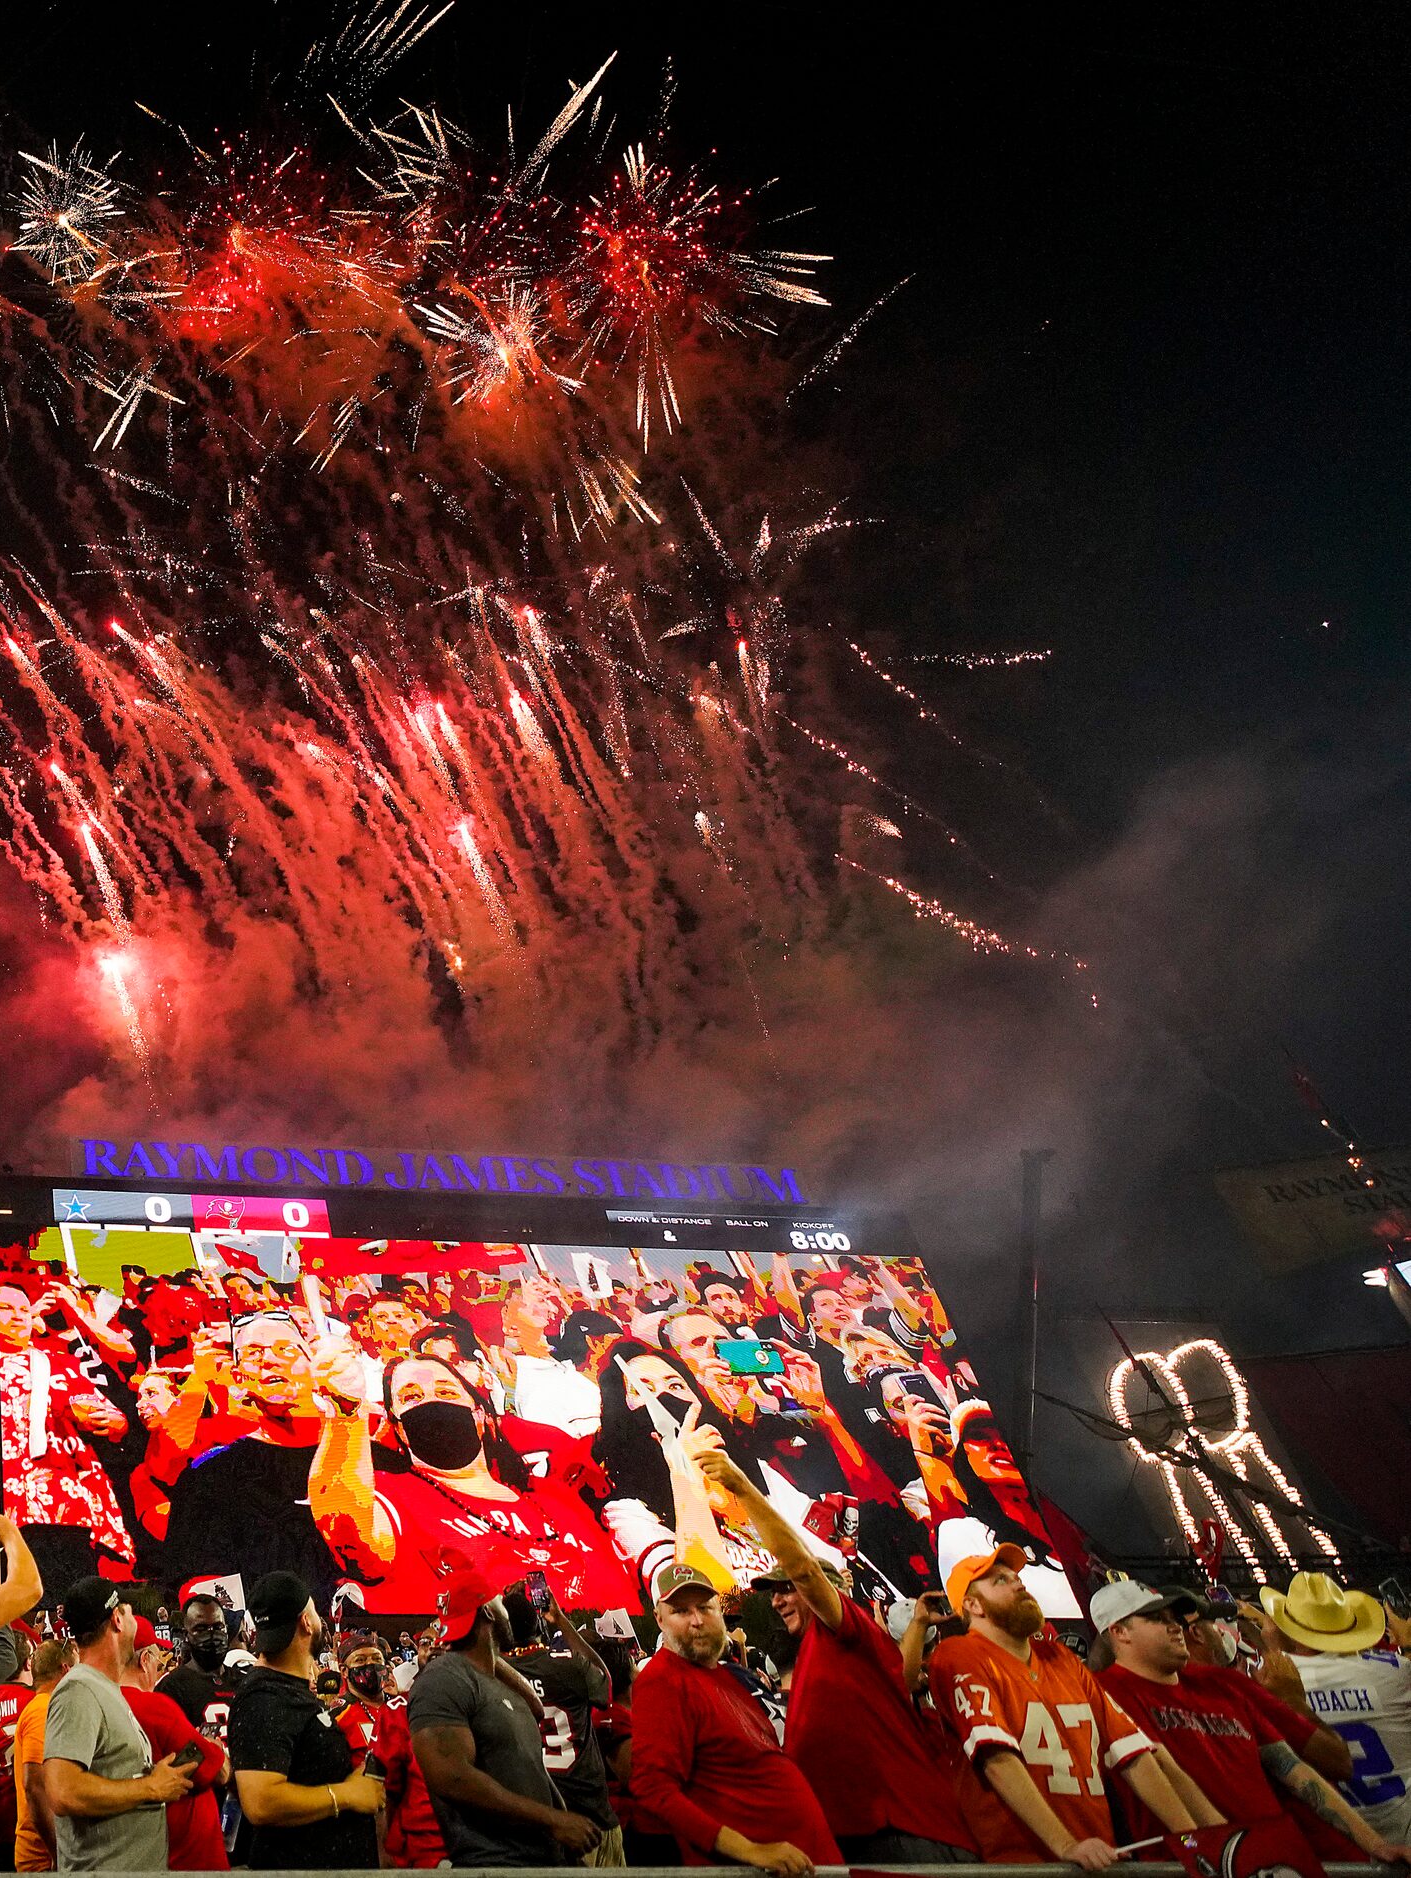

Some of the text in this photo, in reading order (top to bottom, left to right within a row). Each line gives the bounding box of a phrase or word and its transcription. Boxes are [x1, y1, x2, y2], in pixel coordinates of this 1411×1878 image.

[80, 1139, 808, 1204] RAYMOND JAMES STADIUM
[144, 1196, 172, 1223] 0
[282, 1201, 309, 1228] 0
[617, 1215, 650, 1223] DOWN
[661, 1217, 713, 1226] DISTANCE
[725, 1219, 769, 1228] BALL ON
[792, 1221, 835, 1230] KICKOFF
[663, 1230, 677, 1242] &
[789, 1231, 852, 1251] 8:00
[954, 1684, 994, 1719] 47
[1019, 1701, 1105, 1796] 47
